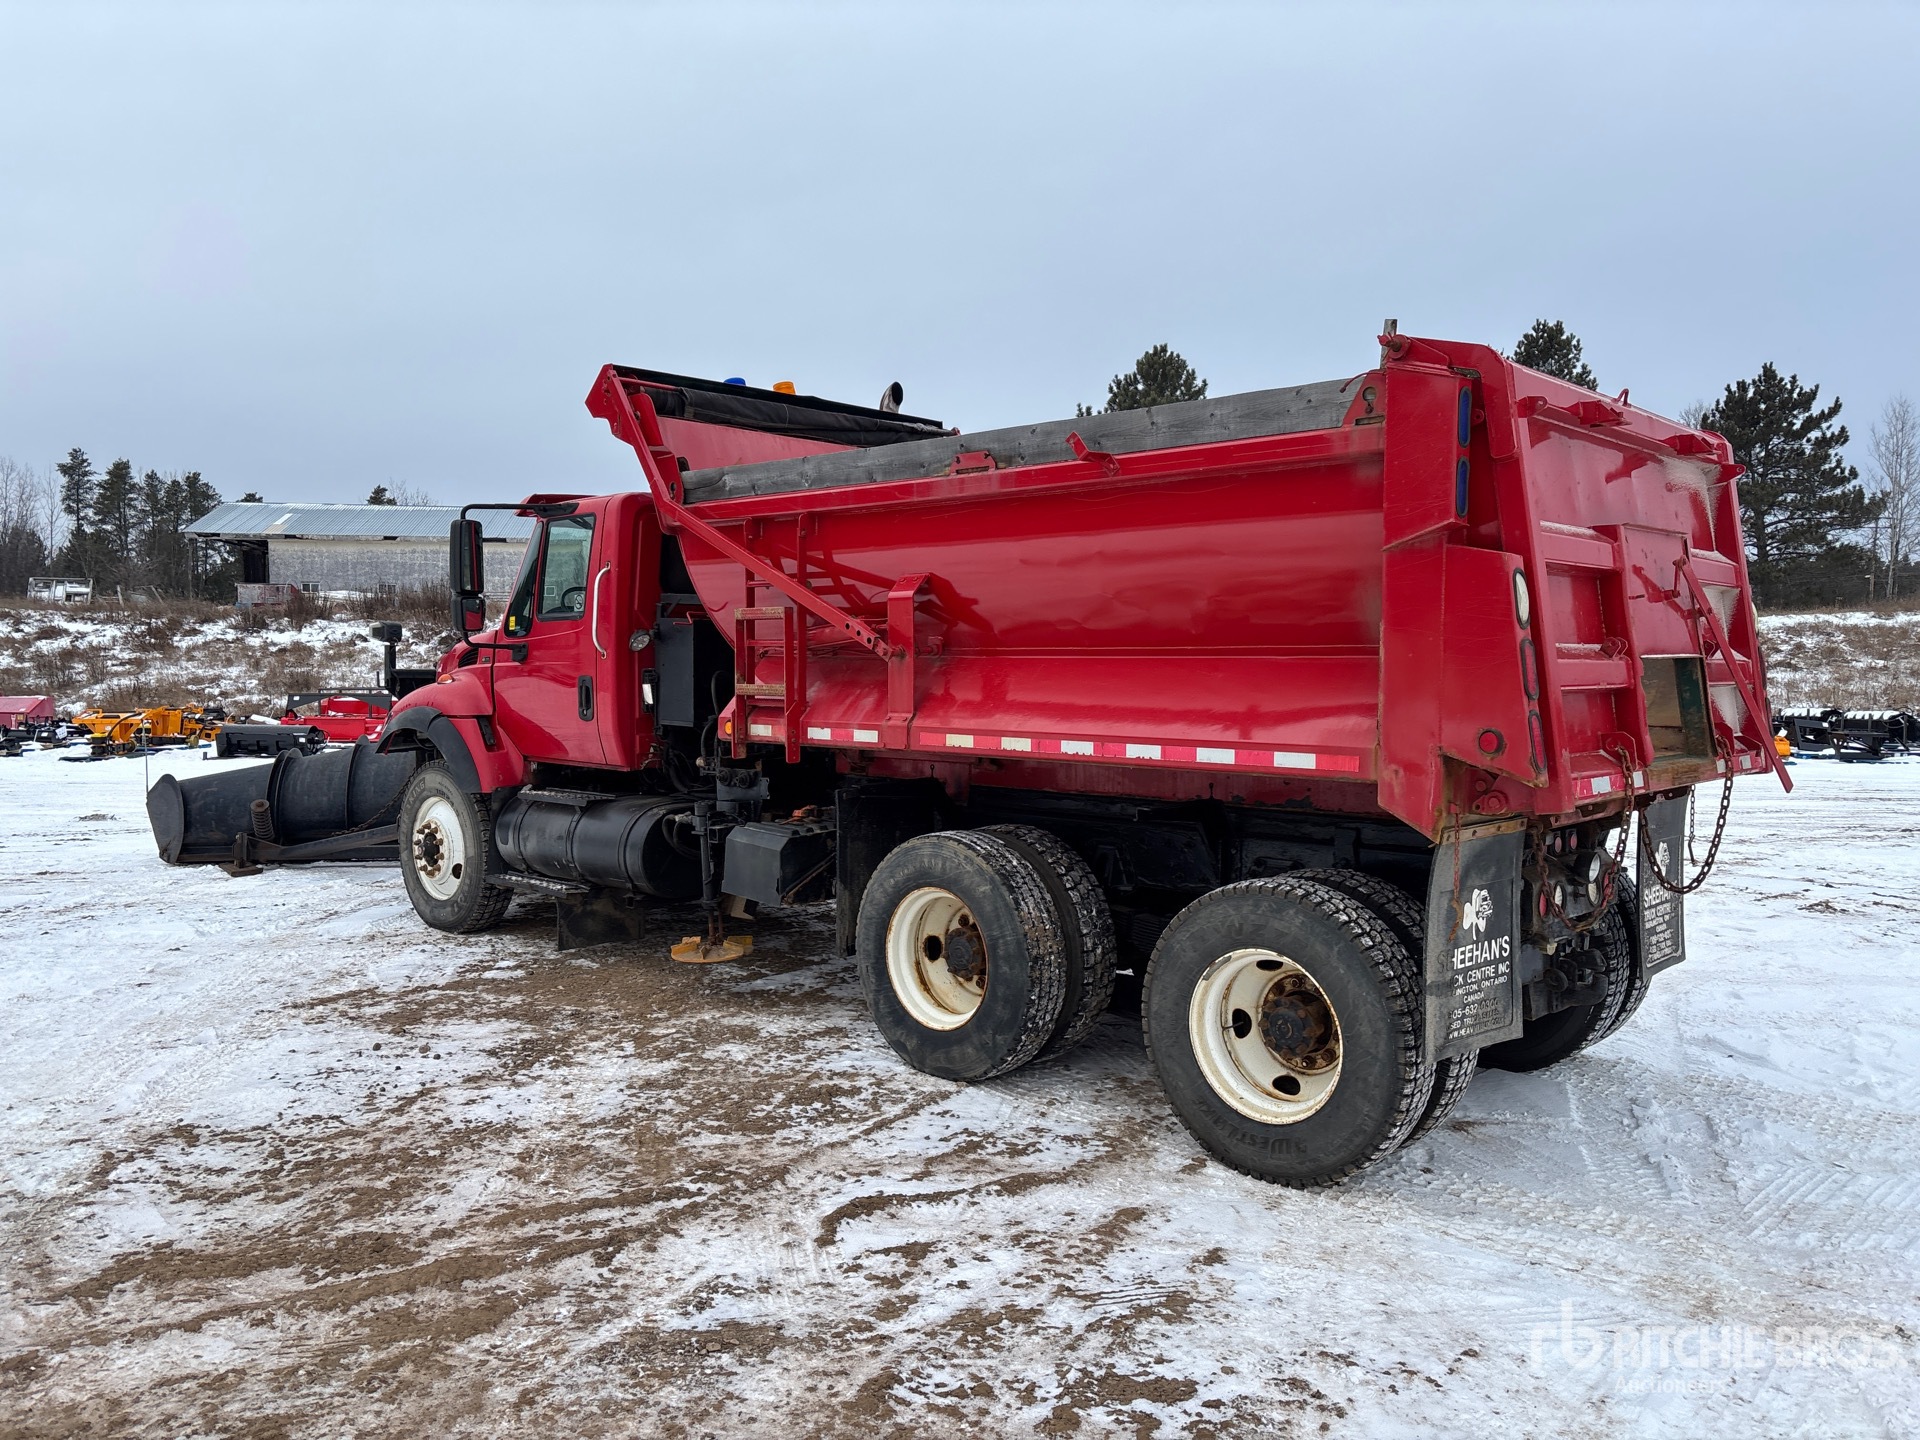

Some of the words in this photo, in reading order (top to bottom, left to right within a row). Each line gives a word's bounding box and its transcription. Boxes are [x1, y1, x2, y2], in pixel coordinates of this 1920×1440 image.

[1467, 965, 1496, 983] CENTRE
[1481, 975, 1508, 989] ONTARIO
[1463, 991, 1485, 1004] CANADA
